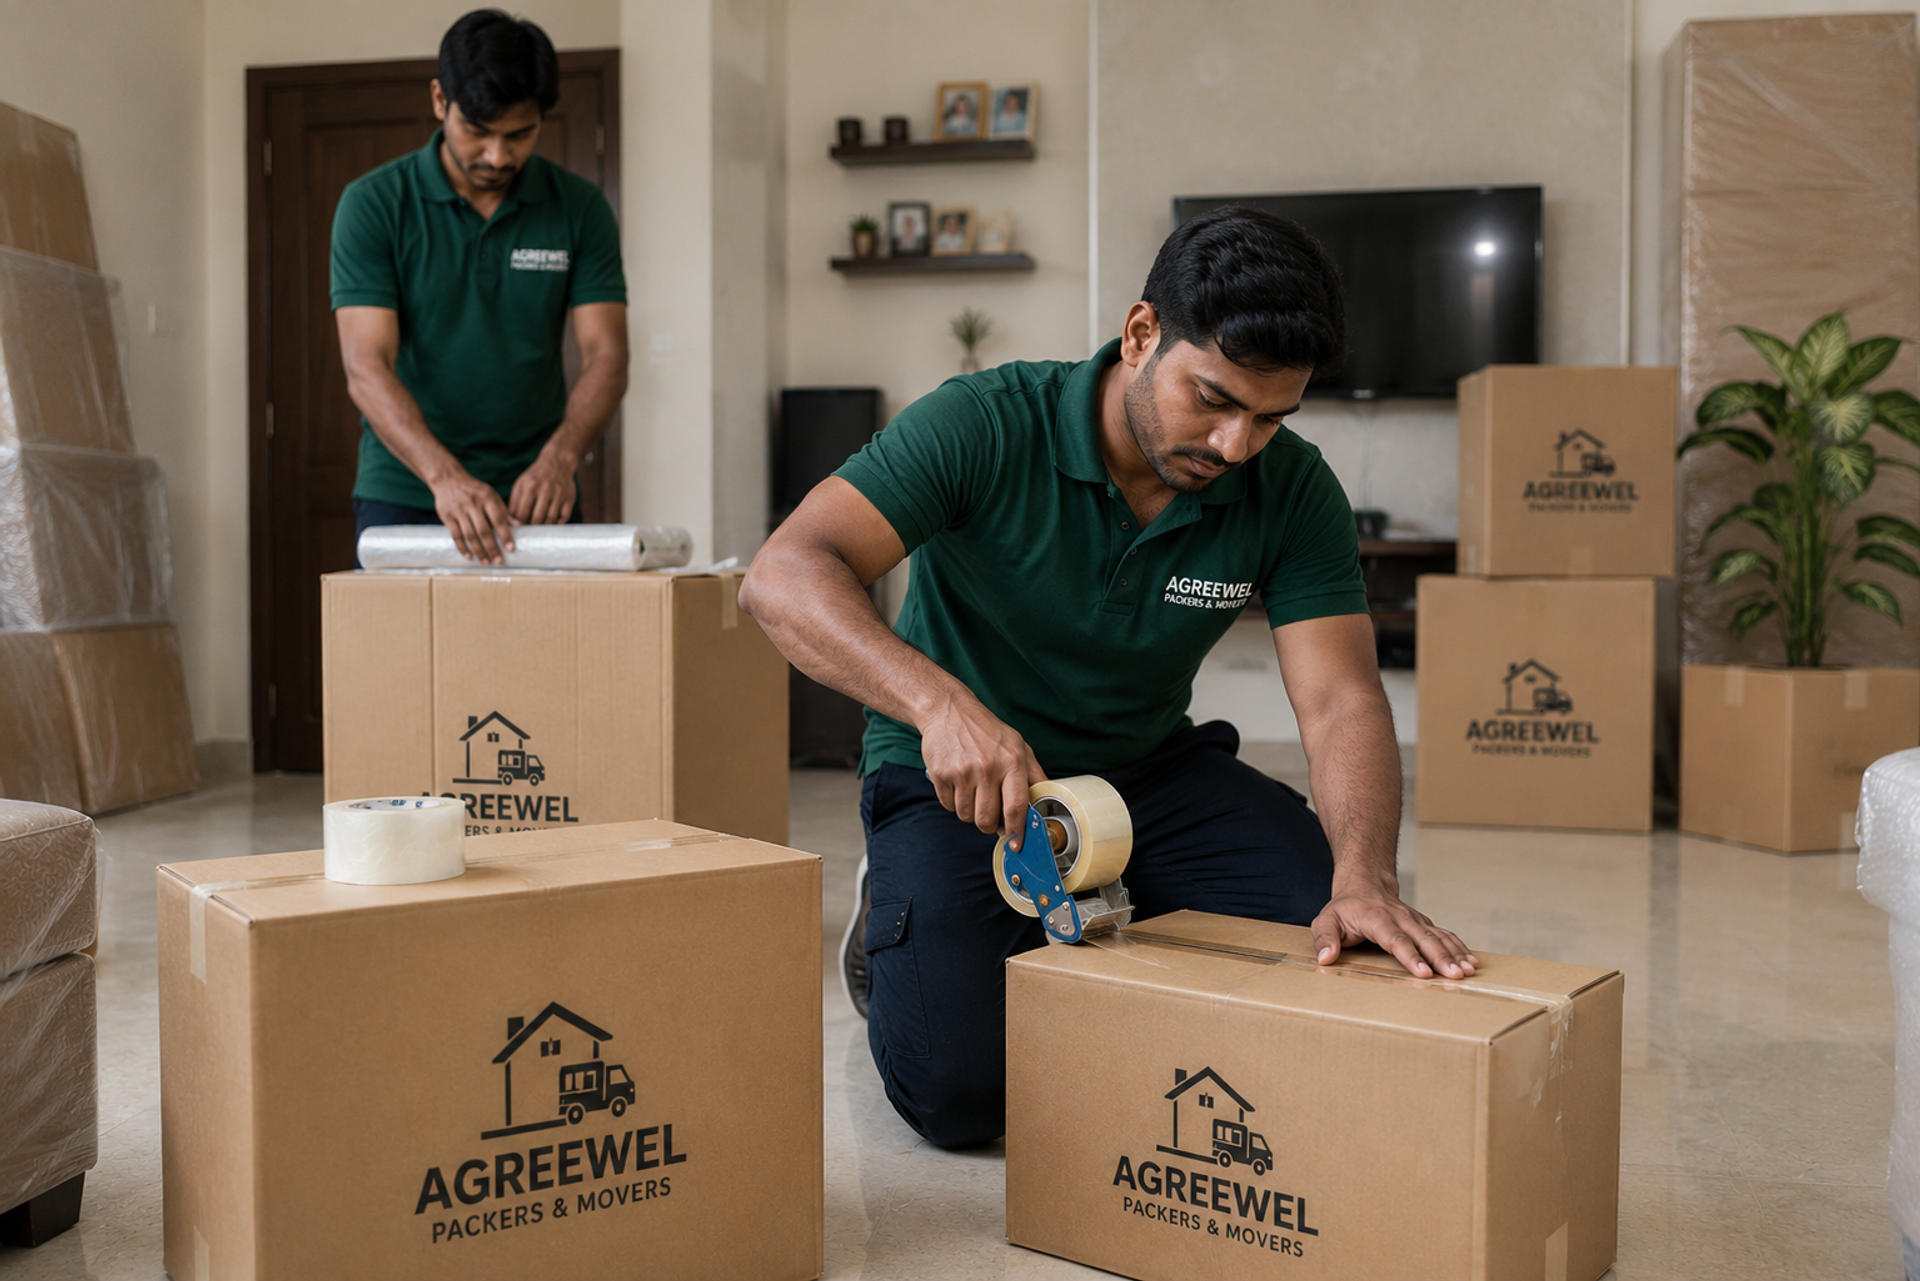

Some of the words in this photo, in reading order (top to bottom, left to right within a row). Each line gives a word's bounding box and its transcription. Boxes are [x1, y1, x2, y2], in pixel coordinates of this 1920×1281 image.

[1523, 480, 1639, 500] AGREEWEL
[1165, 576, 1253, 598] AGREEWEL
[1466, 720, 1600, 743] AGREEWEL
[422, 792, 579, 822] REEWEL
[414, 1124, 687, 1215] AGREEWEL
[432, 1202, 543, 1244] PACKERS
[552, 1198, 568, 1219] &
[577, 1177, 672, 1214] MOVERS
[1112, 1155, 1319, 1236] AGREEWEL
[1123, 1196, 1201, 1230] PACKERS
[1207, 1218, 1219, 1236] &
[1226, 1223, 1304, 1257] MOVERS
